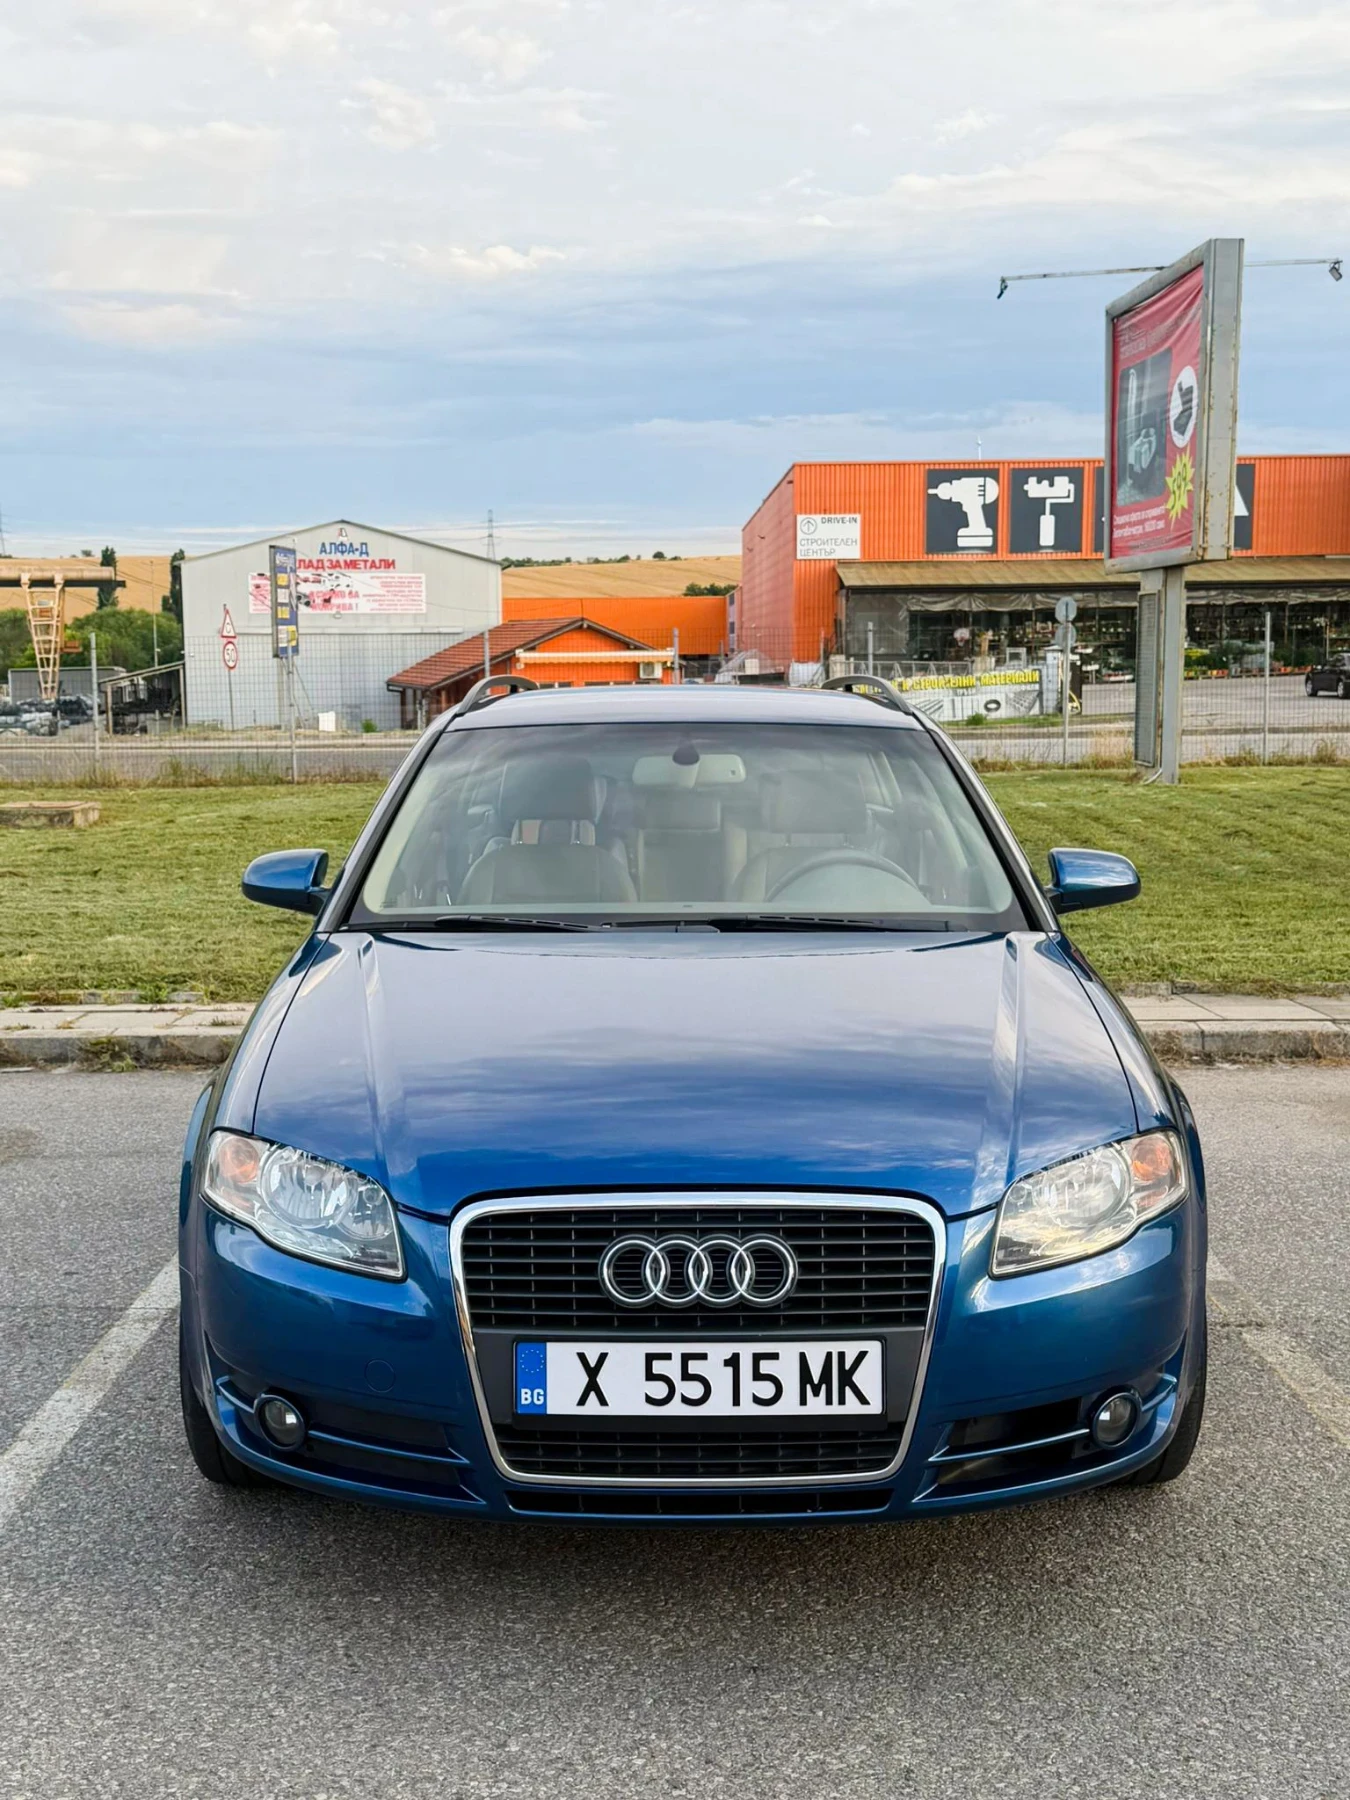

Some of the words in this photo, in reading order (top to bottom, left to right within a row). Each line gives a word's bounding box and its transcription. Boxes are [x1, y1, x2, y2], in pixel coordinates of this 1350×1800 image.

[319, 542, 369, 557] АЛФА-Д
[799, 538, 858, 547] СТРОИТЕЛЕН
[799, 548, 836, 557] ЦЕНТЪР
[297, 559, 325, 571] ЛАД
[326, 559, 342, 570] ЗА
[343, 559, 396, 570] МЕТАЛИ
[226, 648, 236, 663] 50
[979, 670, 1039, 686] МАТЕРИАЛИ
[575, 1351, 610, 1407] X
[644, 1351, 784, 1407] 5515
[798, 1350, 872, 1407] MK
[520, 1389, 545, 1405] BG
